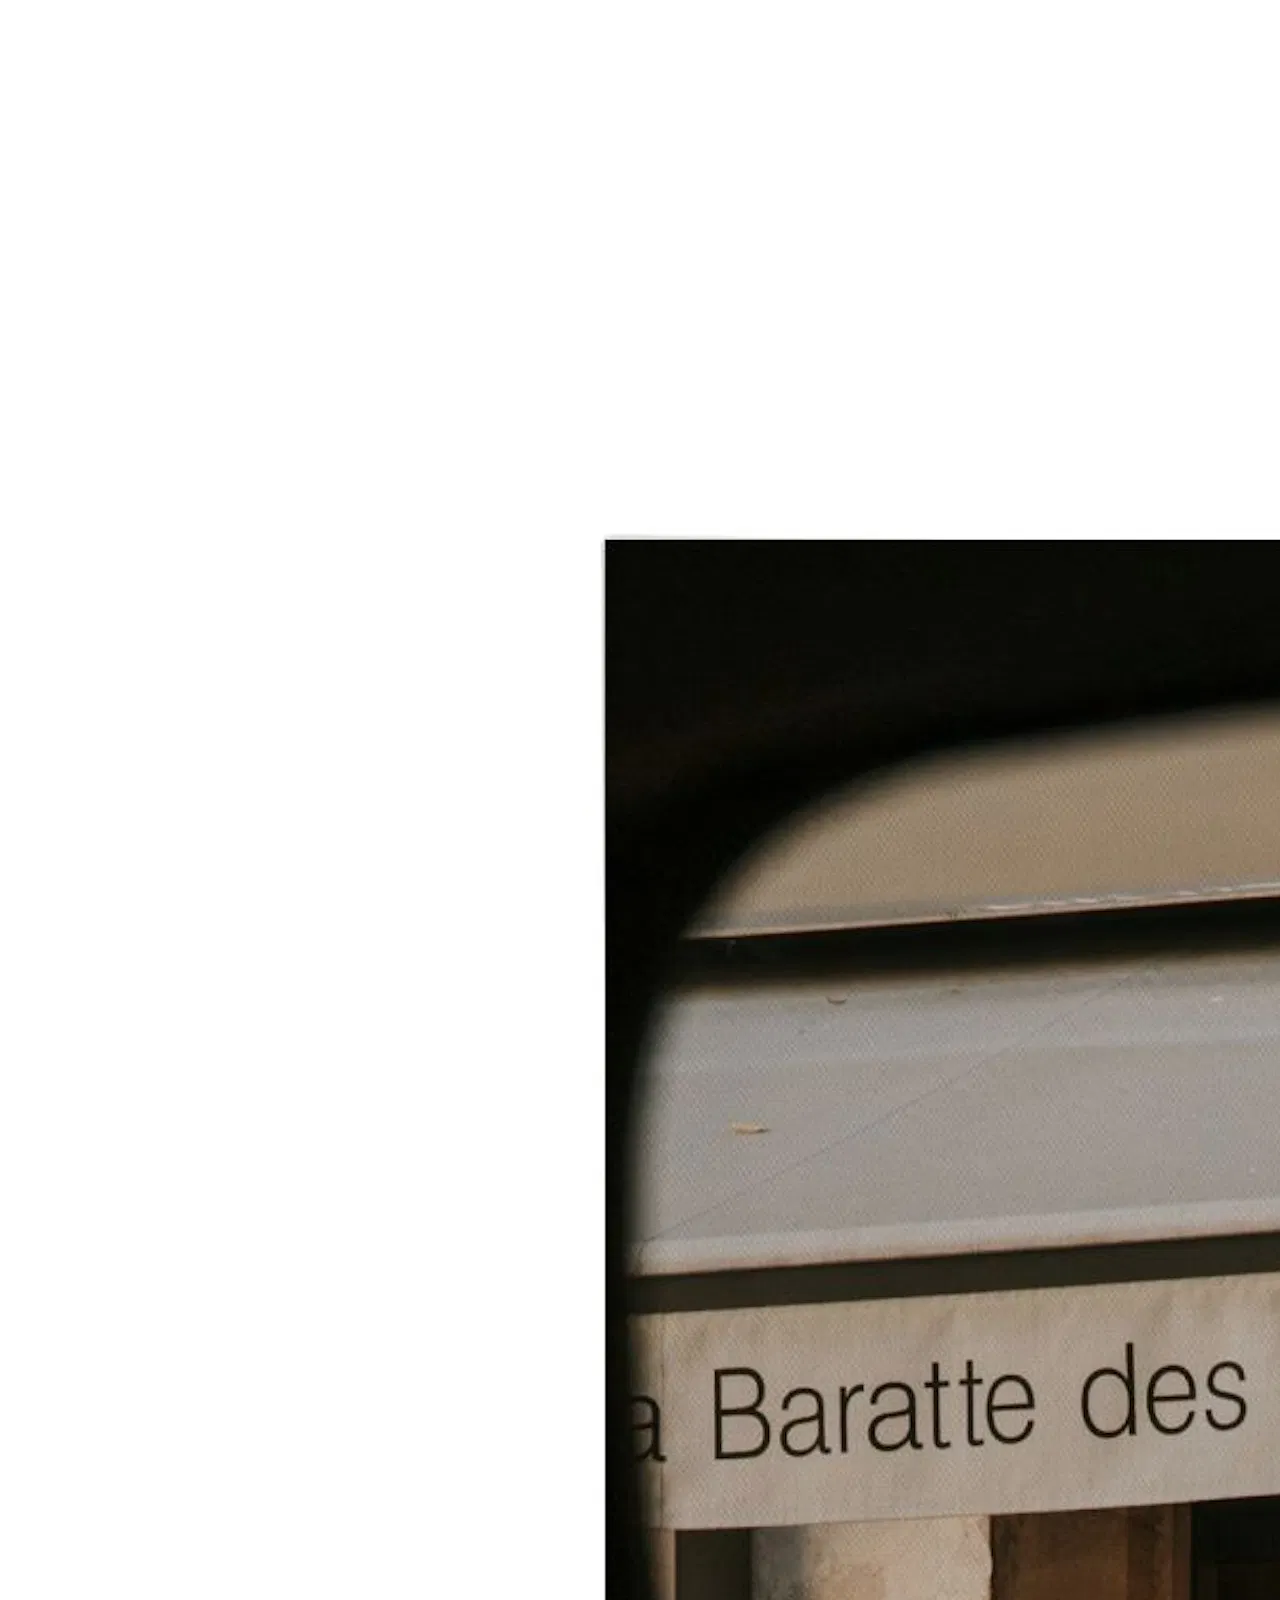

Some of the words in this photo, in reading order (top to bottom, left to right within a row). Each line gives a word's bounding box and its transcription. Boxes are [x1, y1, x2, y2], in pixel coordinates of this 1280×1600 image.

[631, 1394, 667, 1463] a
[713, 1357, 1036, 1460] Baratte
[1081, 1341, 1248, 1439] des
